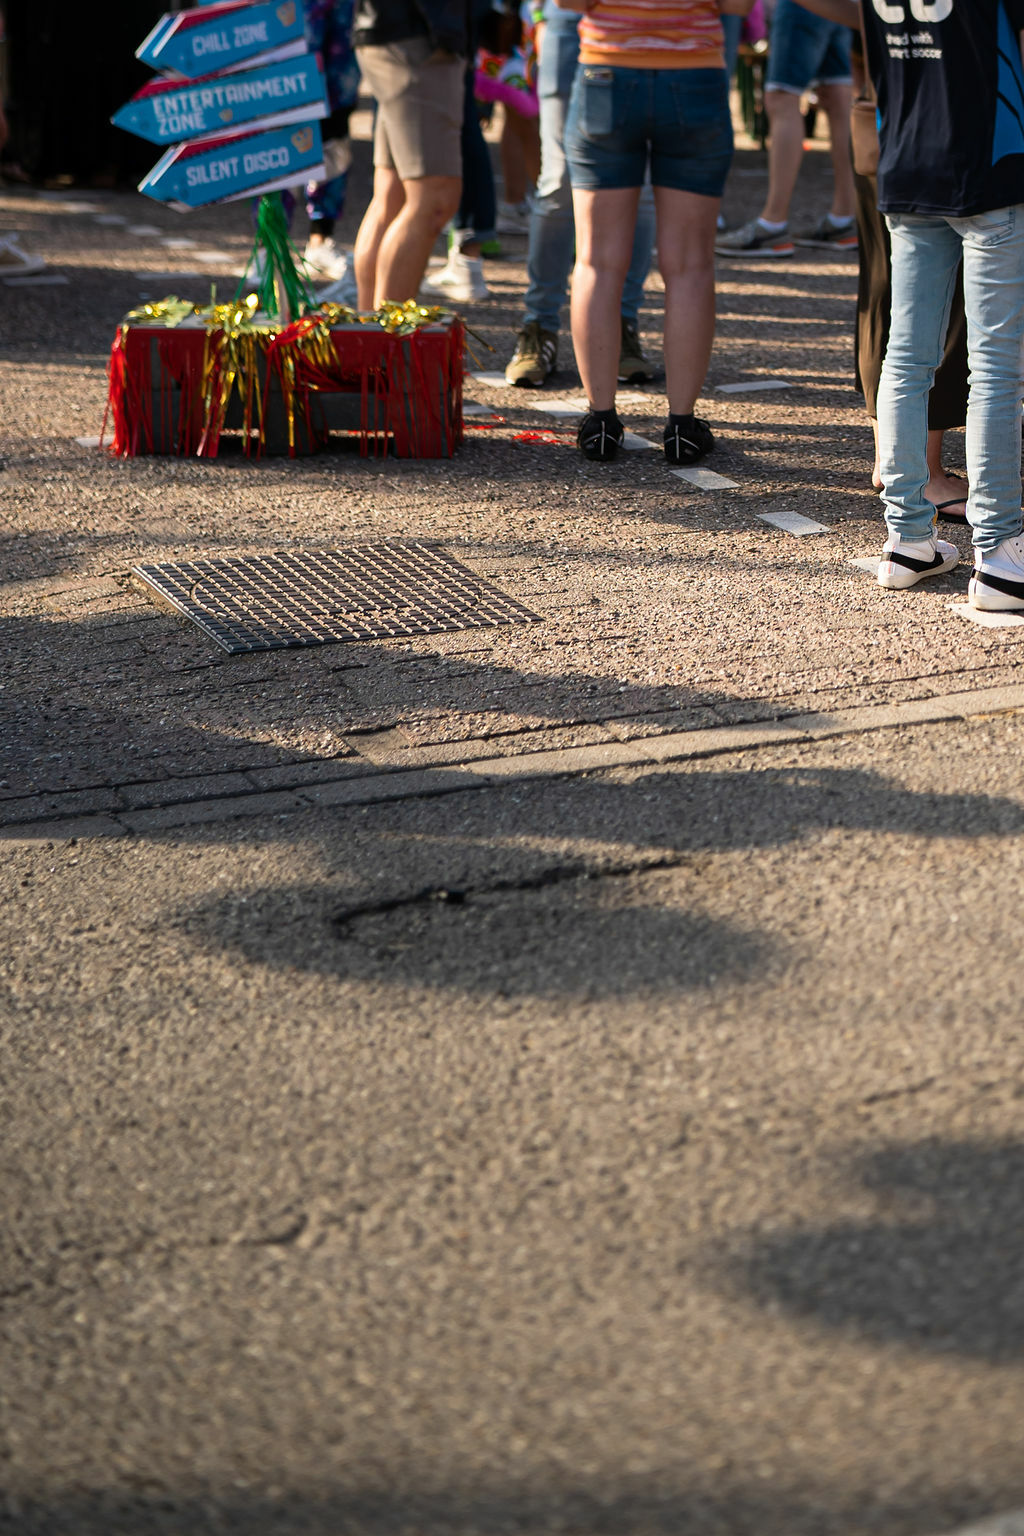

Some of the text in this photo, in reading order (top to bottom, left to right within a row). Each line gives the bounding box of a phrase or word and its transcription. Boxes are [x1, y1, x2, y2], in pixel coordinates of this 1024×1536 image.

[192, 21, 269, 57] CHILL ZONE
[153, 72, 307, 116] ENTERTAINMENT
[157, 112, 207, 136] ZONE
[186, 146, 289, 187] SILENT DISCO
